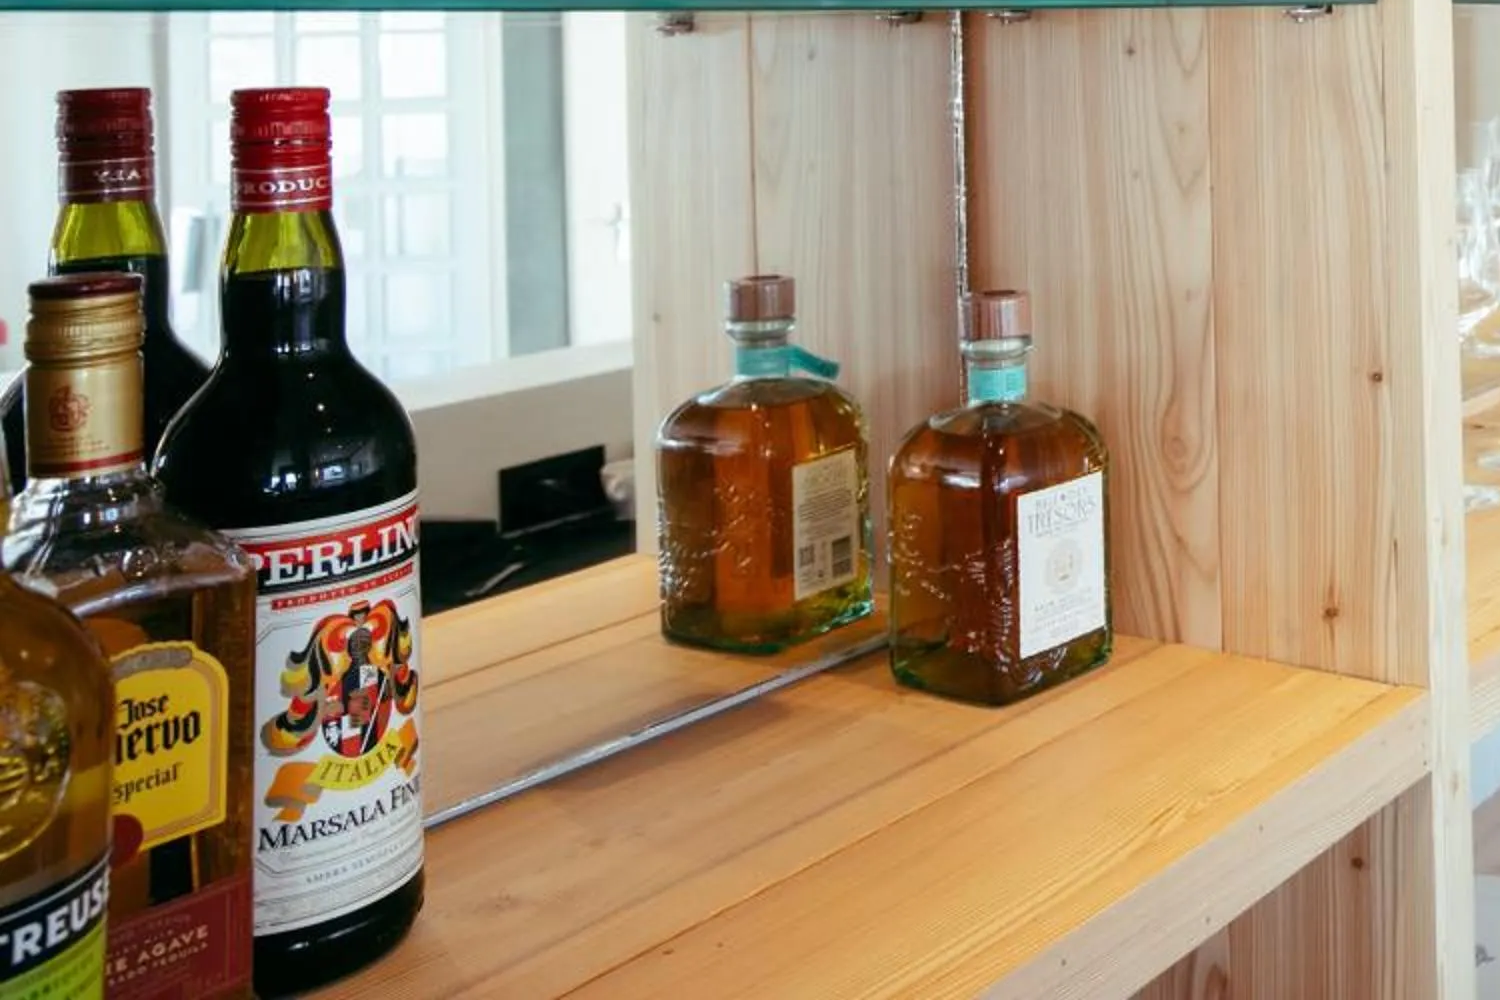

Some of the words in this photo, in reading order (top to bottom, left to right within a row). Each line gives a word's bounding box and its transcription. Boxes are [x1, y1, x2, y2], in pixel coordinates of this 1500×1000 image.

[114, 710, 201, 766] ervo
[112, 760, 184, 807] special
[319, 742, 397, 784] ITALIA
[258, 798, 386, 850] MARSALA
[0, 877, 105, 967] REUS
[138, 924, 208, 963] AGAVE
